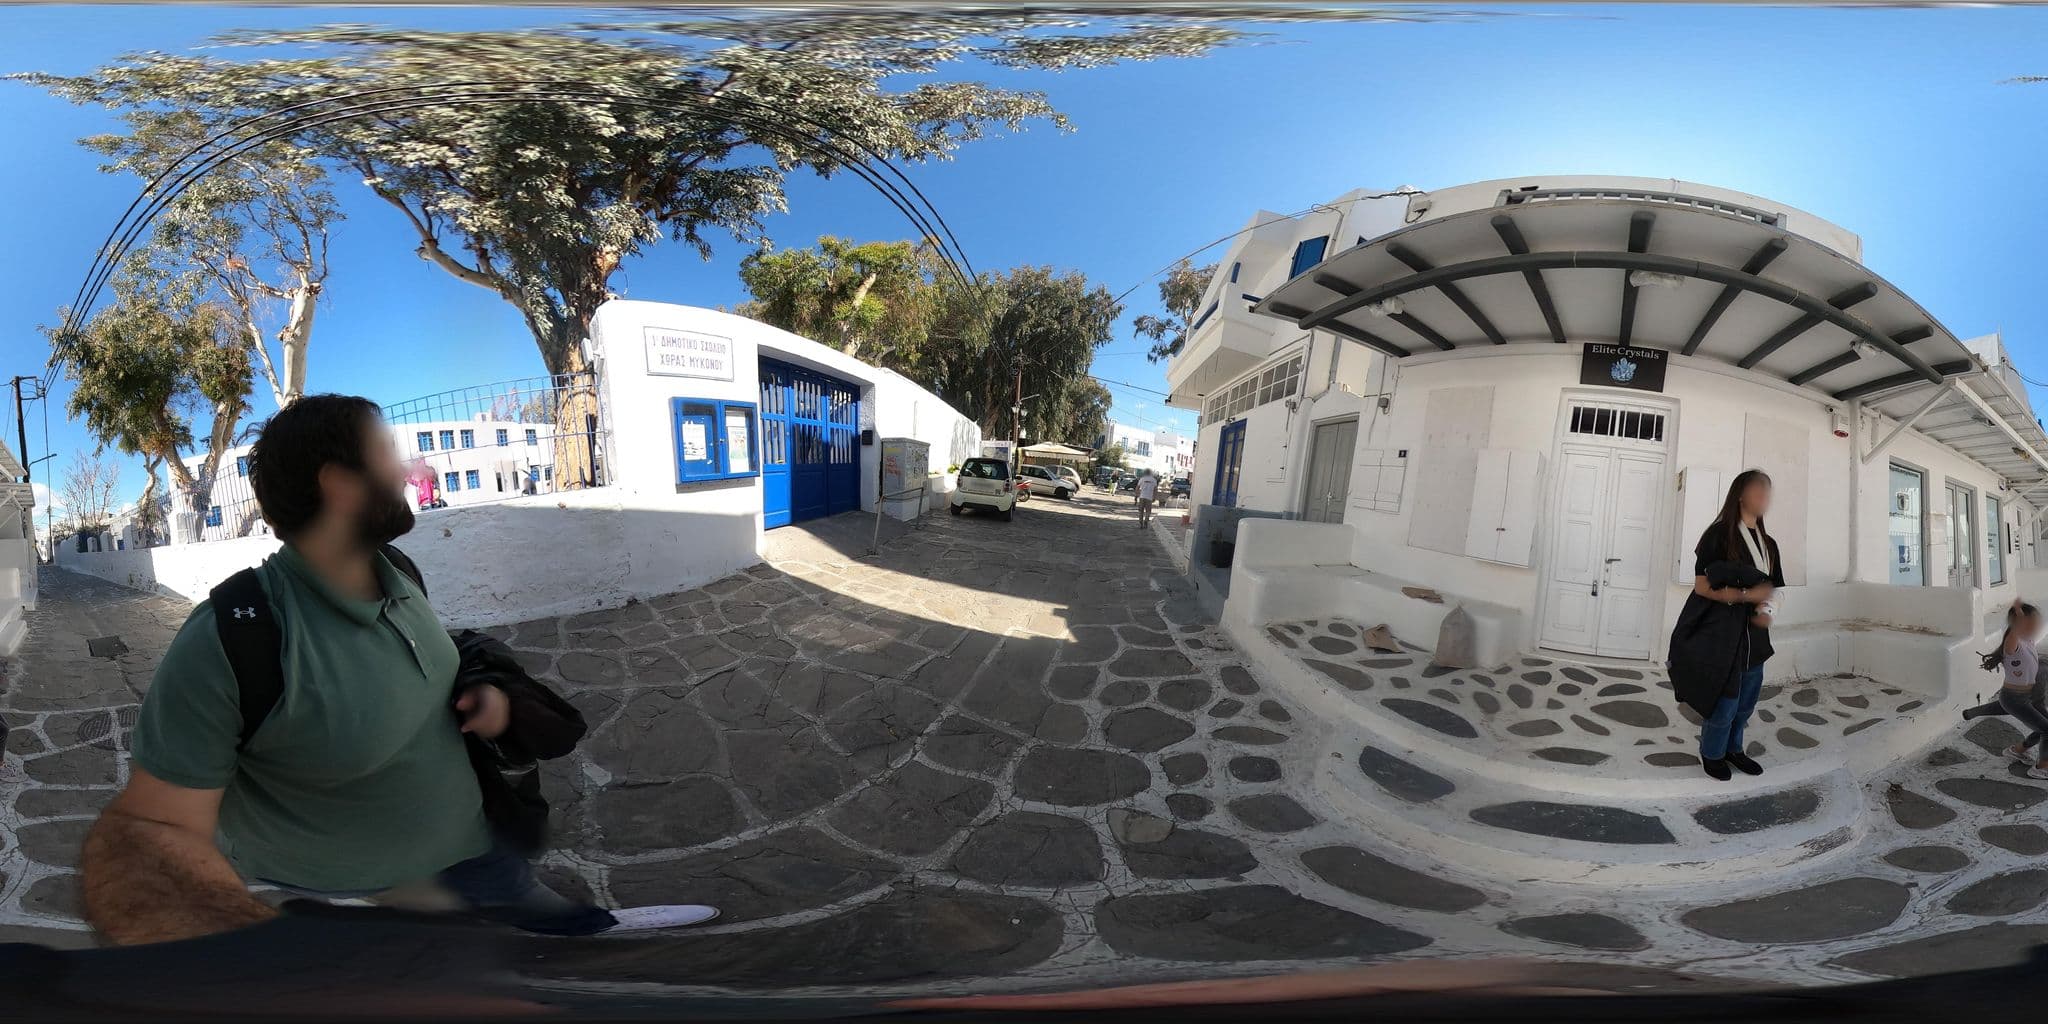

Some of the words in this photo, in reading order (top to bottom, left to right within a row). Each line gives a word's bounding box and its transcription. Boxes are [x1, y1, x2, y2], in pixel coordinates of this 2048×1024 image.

[661, 335, 697, 350] ΔΗΜΟΤΙΚΟ
[1592, 345, 1616, 354] Elite
[1617, 347, 1660, 360] Crystals
[660, 353, 685, 367] ΧΩΡΑΣ
[689, 356, 722, 371] ΜΥΚΟΝΟΥ
